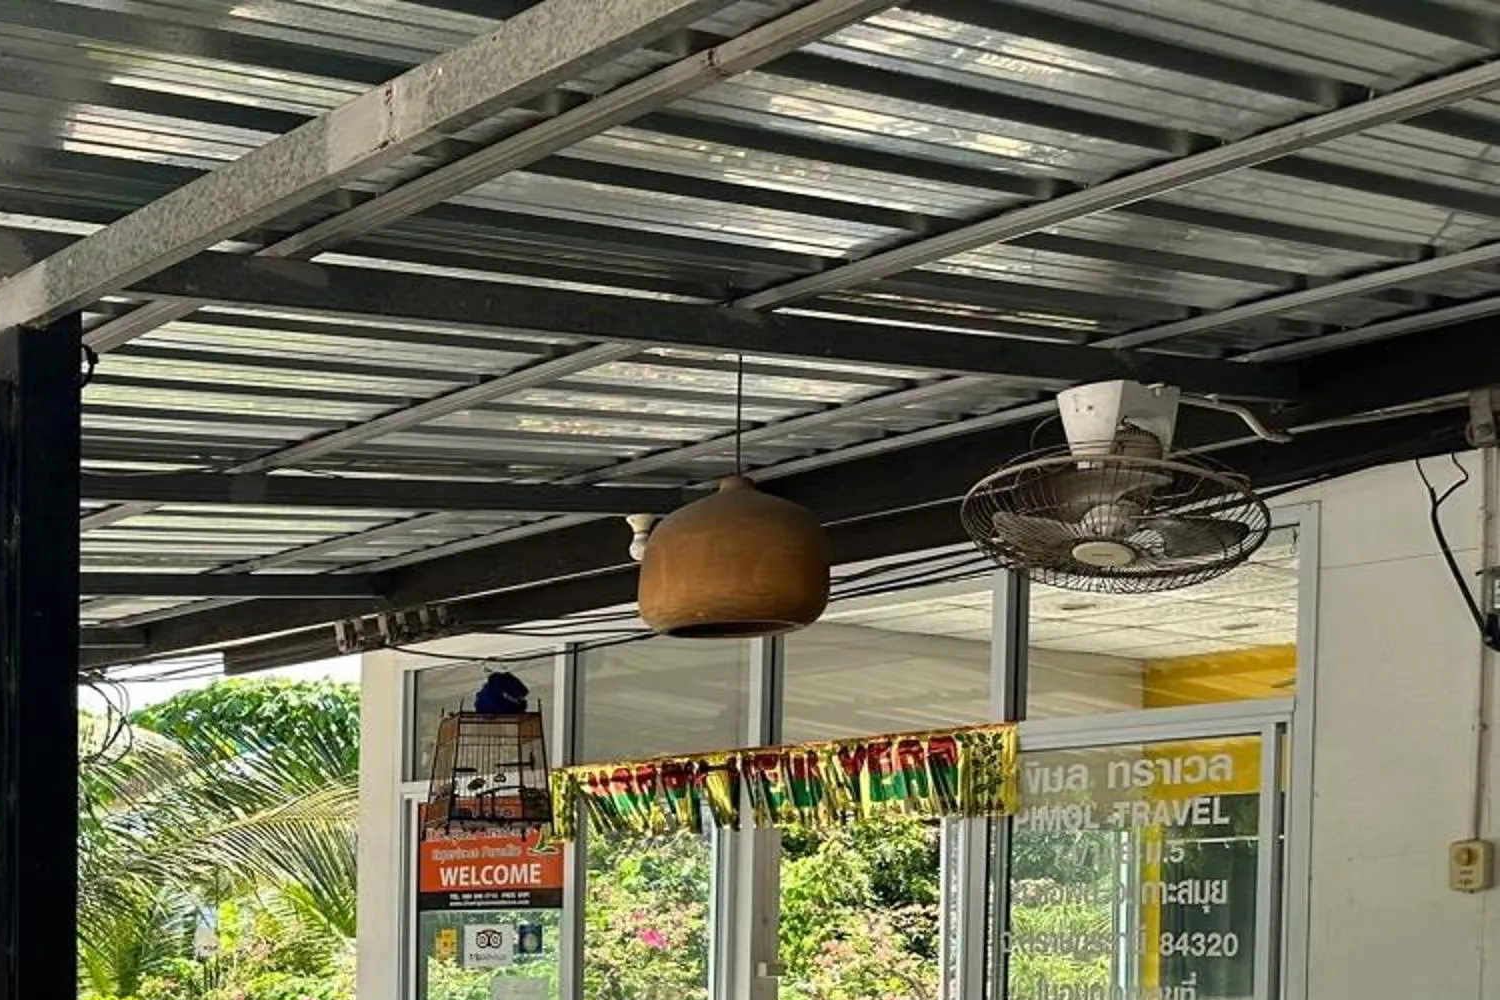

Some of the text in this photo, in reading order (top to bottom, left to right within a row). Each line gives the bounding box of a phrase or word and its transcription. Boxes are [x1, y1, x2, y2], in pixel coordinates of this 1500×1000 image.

[1106, 752, 1233, 789] ทราเวล
[1111, 796, 1230, 829] TRAVEL
[440, 863, 541, 887] WELCOME
[1160, 931, 1239, 958] 84320
